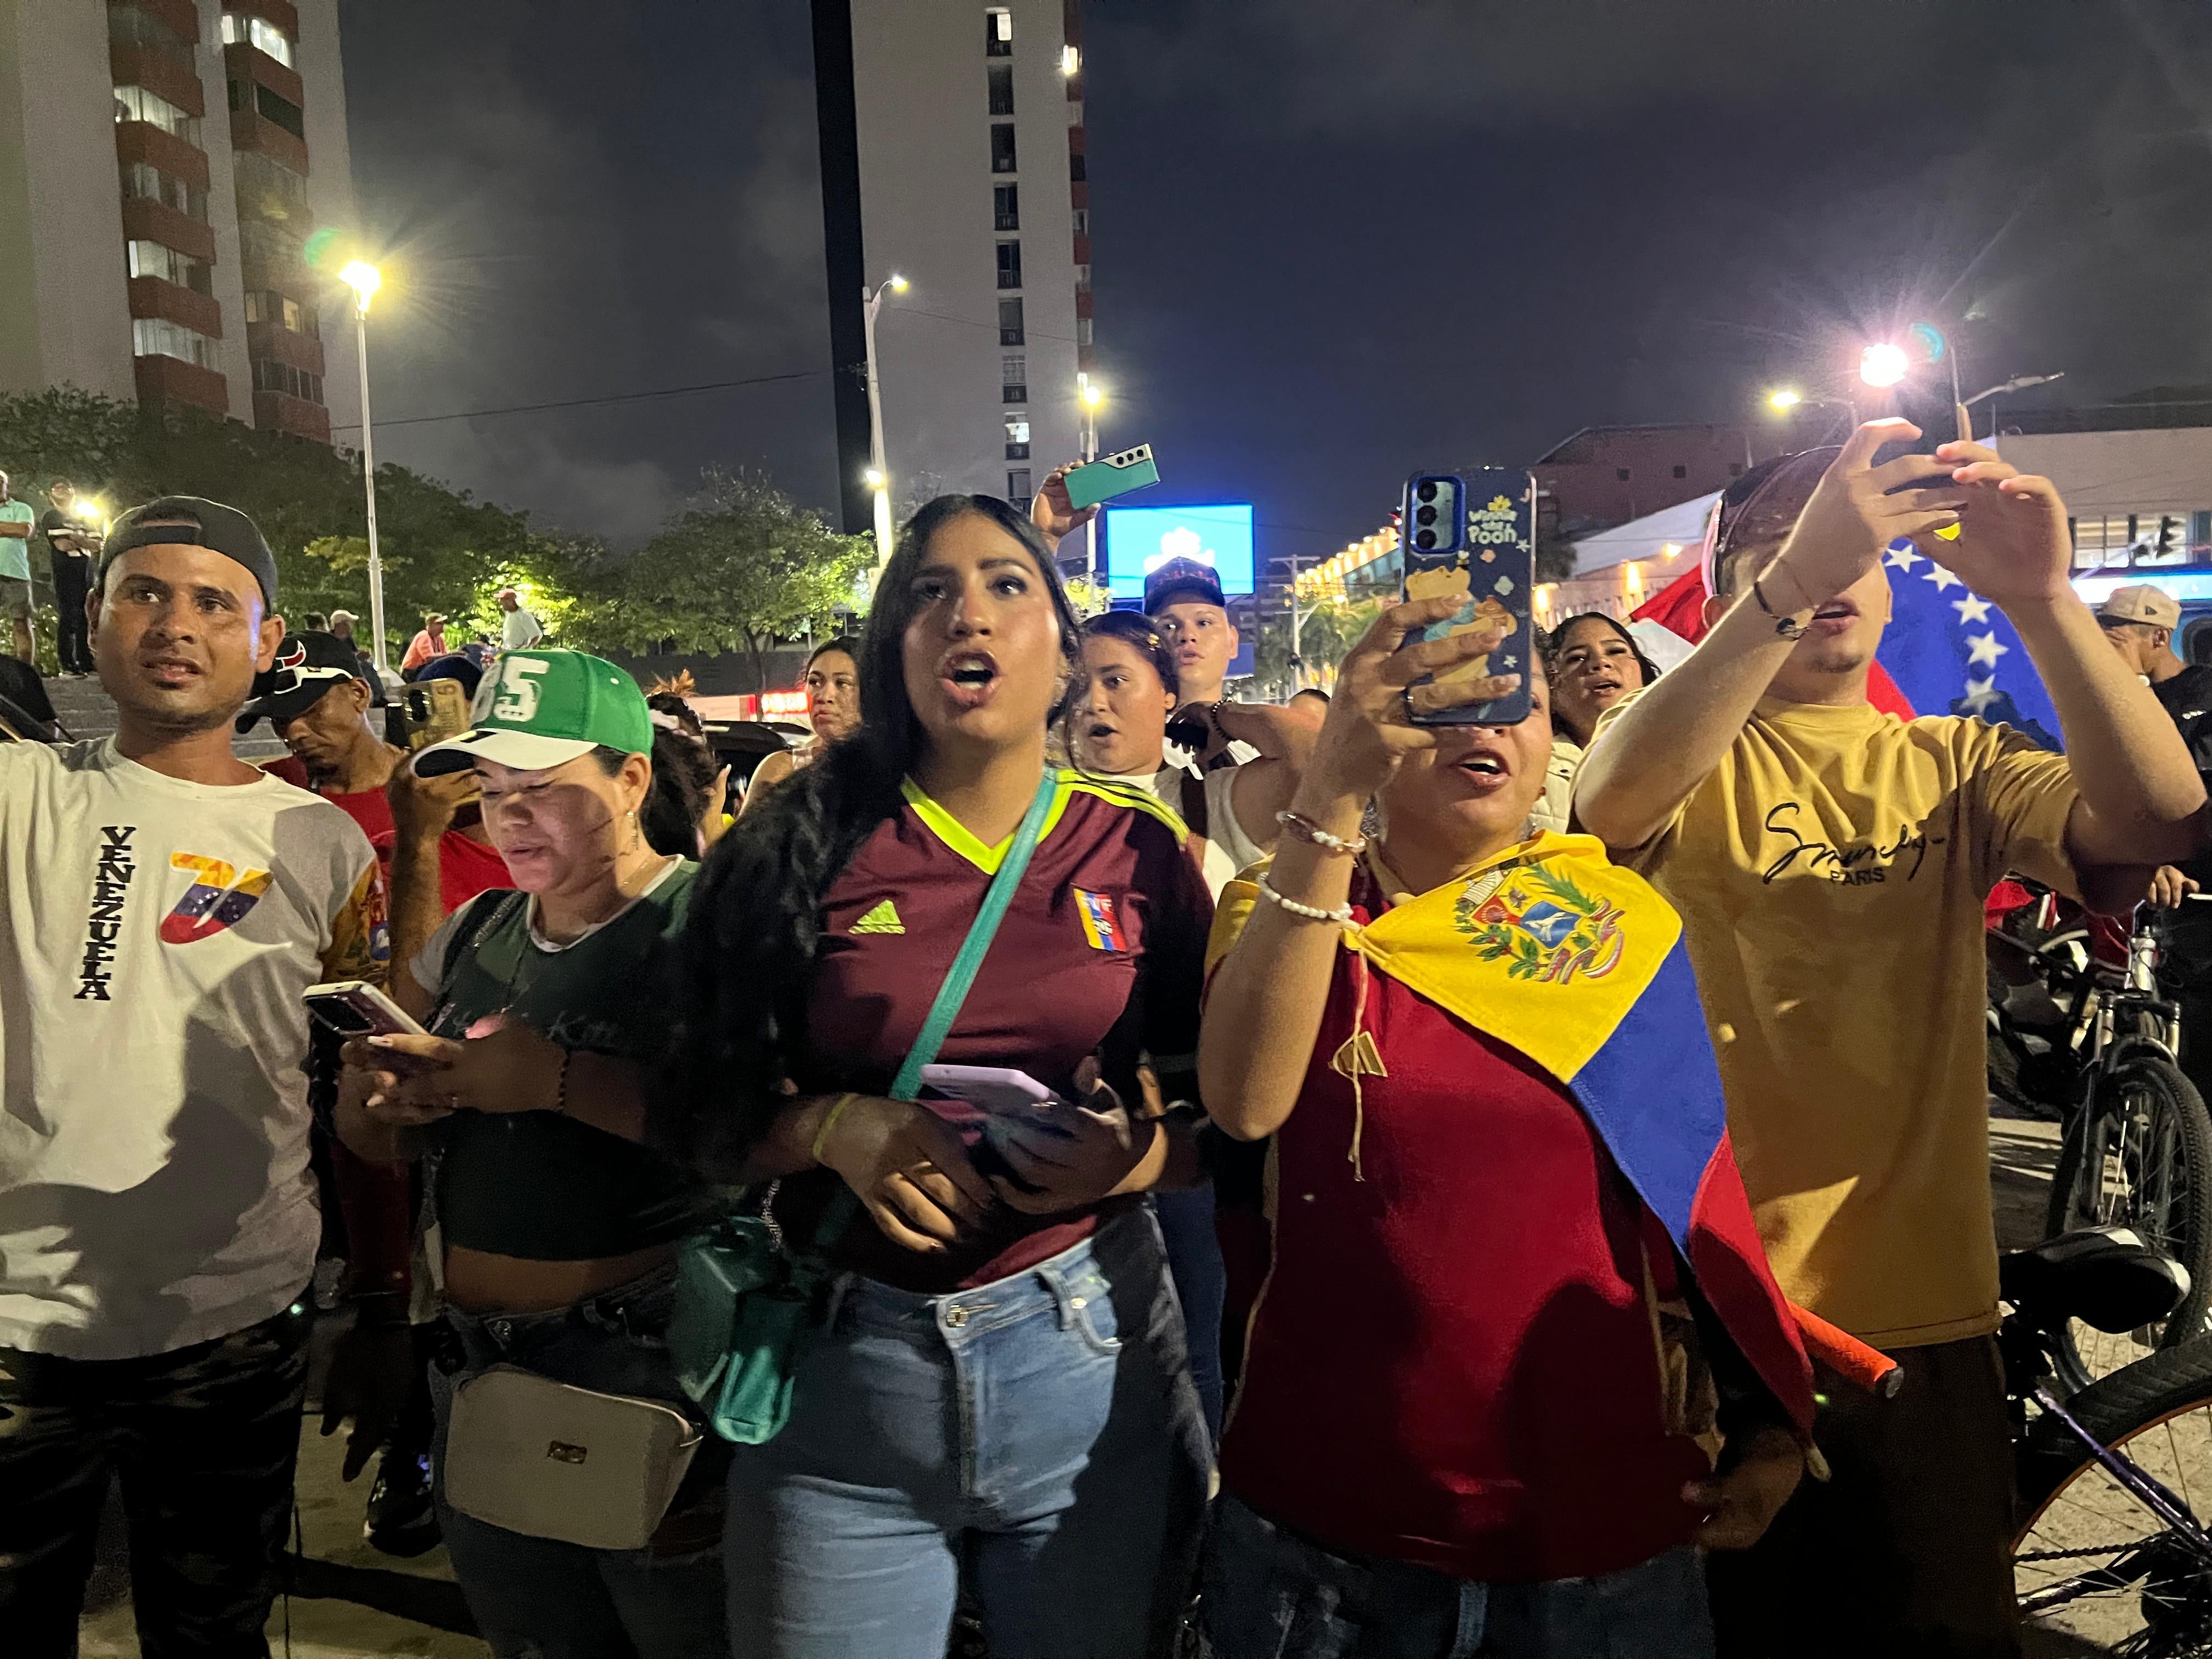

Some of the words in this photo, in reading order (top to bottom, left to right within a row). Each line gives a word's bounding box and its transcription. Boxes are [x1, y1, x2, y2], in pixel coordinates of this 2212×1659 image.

[1468, 523, 1517, 544] Pooh
[1830, 867, 1885, 886] PARIS
[74, 826, 137, 1001] VENEZUELA
